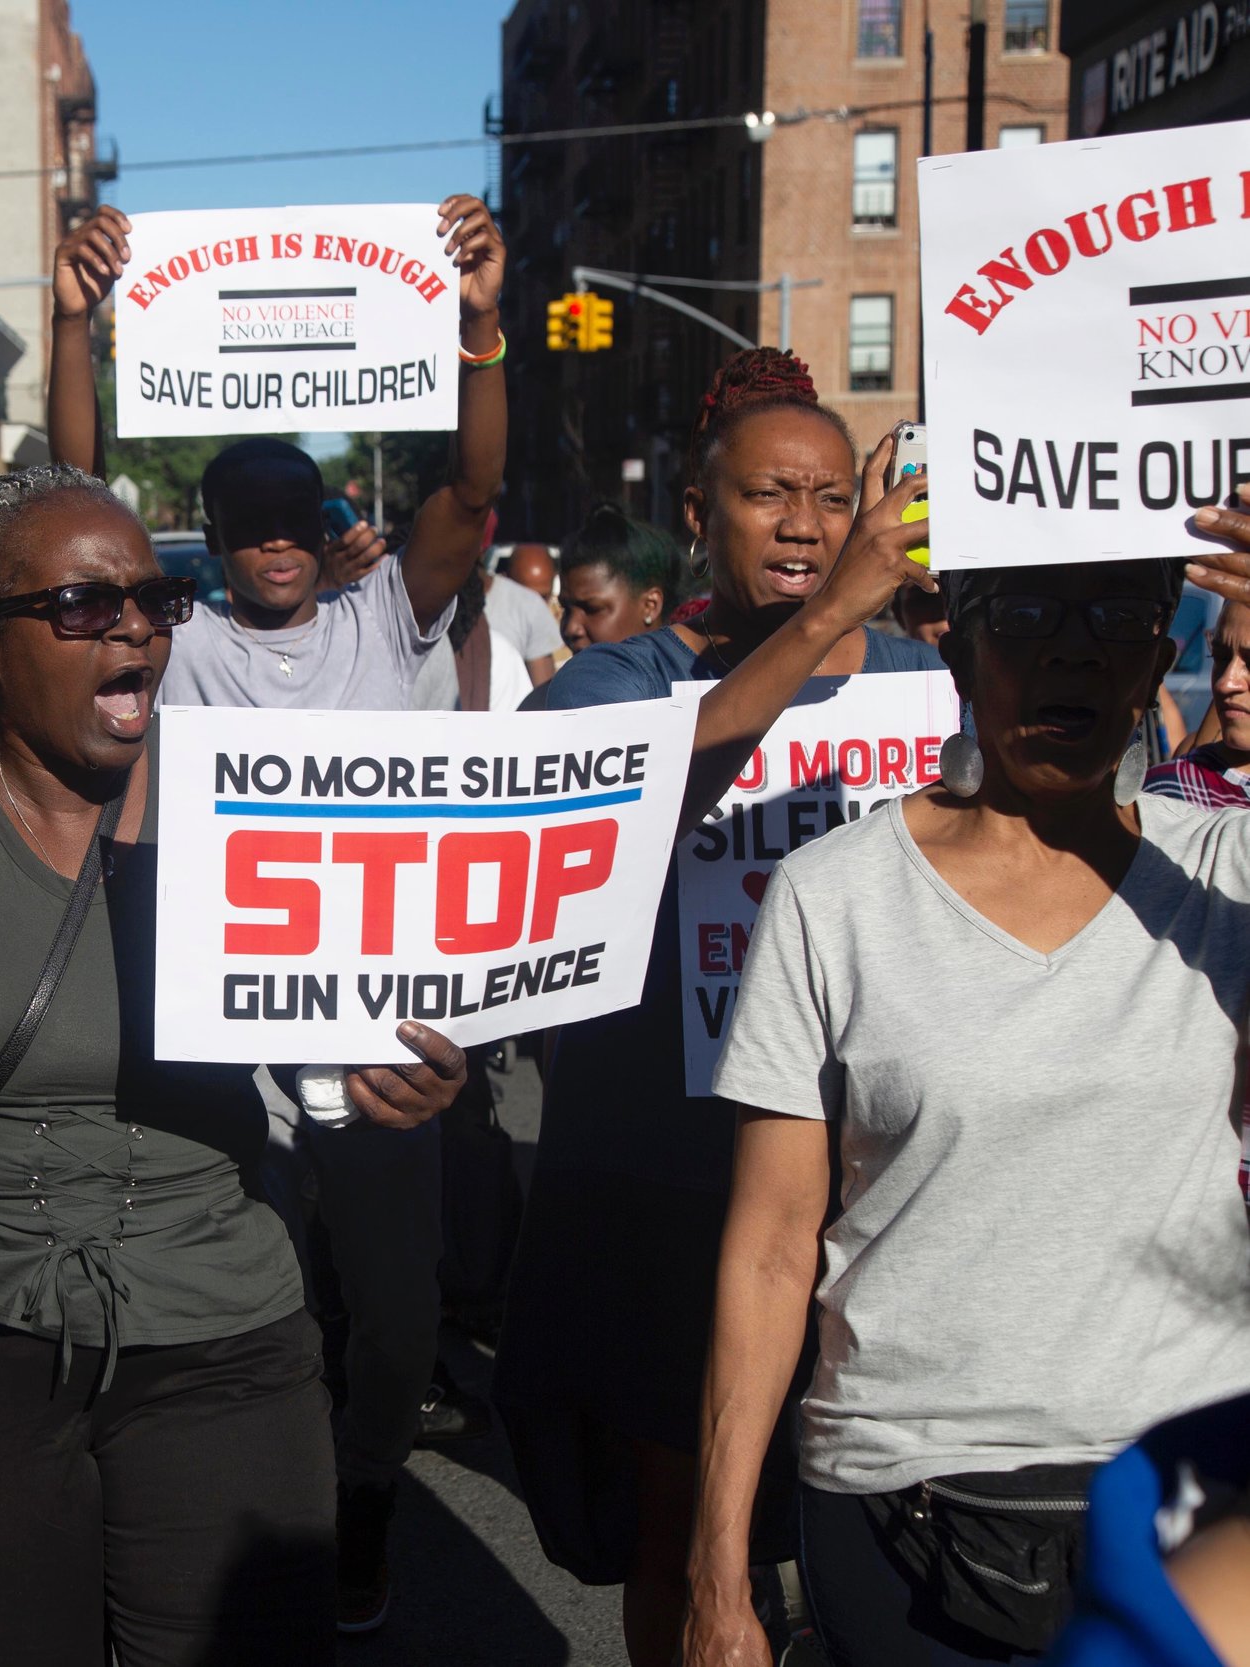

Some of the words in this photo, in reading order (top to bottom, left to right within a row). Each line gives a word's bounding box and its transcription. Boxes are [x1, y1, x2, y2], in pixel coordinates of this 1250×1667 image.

[1111, 28, 1167, 113] RITE
[1168, 1, 1218, 88] AID
[126, 234, 259, 311] ENOUGH
[271, 233, 302, 259] IS
[313, 234, 448, 304] ENOUGH
[944, 177, 1216, 336] ENOUGH
[223, 305, 251, 322] NO
[257, 303, 355, 321] VIOLENCE
[223, 323, 285, 340] KNOW
[293, 321, 354, 339] PEACE
[1136, 314, 1197, 346] NO
[139, 362, 213, 409] SAVE
[222, 372, 282, 410] OUR
[291, 353, 436, 409] CHILDREN
[973, 428, 1121, 511] SAVE
[215, 753, 291, 795] NO
[300, 755, 449, 798] MORE
[460, 743, 650, 798] SILENCE
[788, 736, 942, 792] MORE
[224, 818, 619, 956] STOP
[223, 974, 338, 1020] GUN
[358, 942, 606, 1020] VIOLENCE
